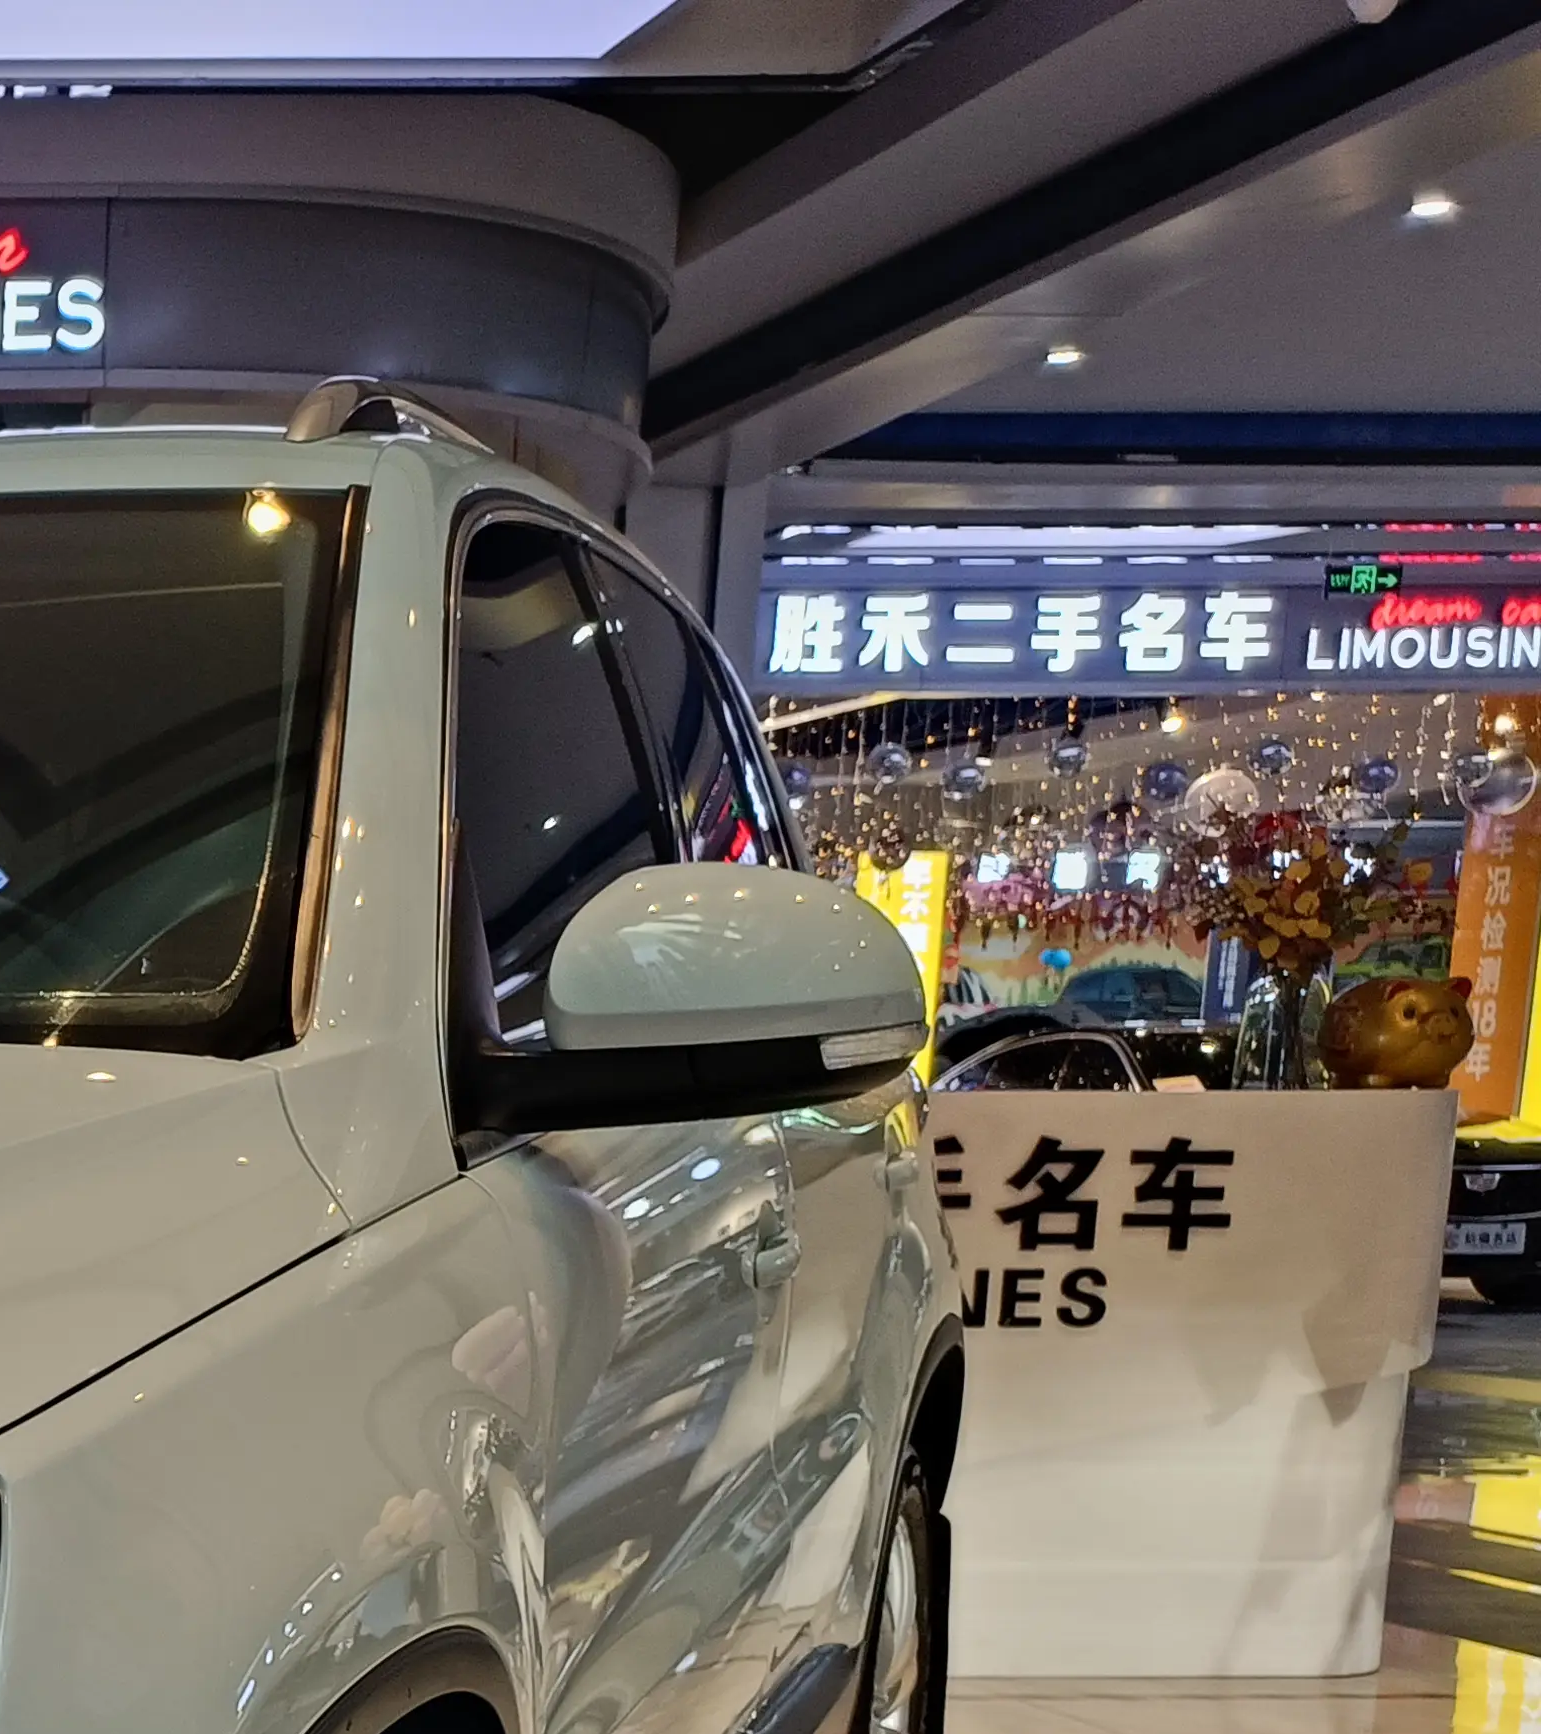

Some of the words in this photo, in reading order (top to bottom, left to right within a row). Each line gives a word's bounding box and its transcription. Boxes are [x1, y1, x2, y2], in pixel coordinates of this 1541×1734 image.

[769, 591, 1274, 673] 胜禾二手名车
[1371, 592, 1482, 631] dream
